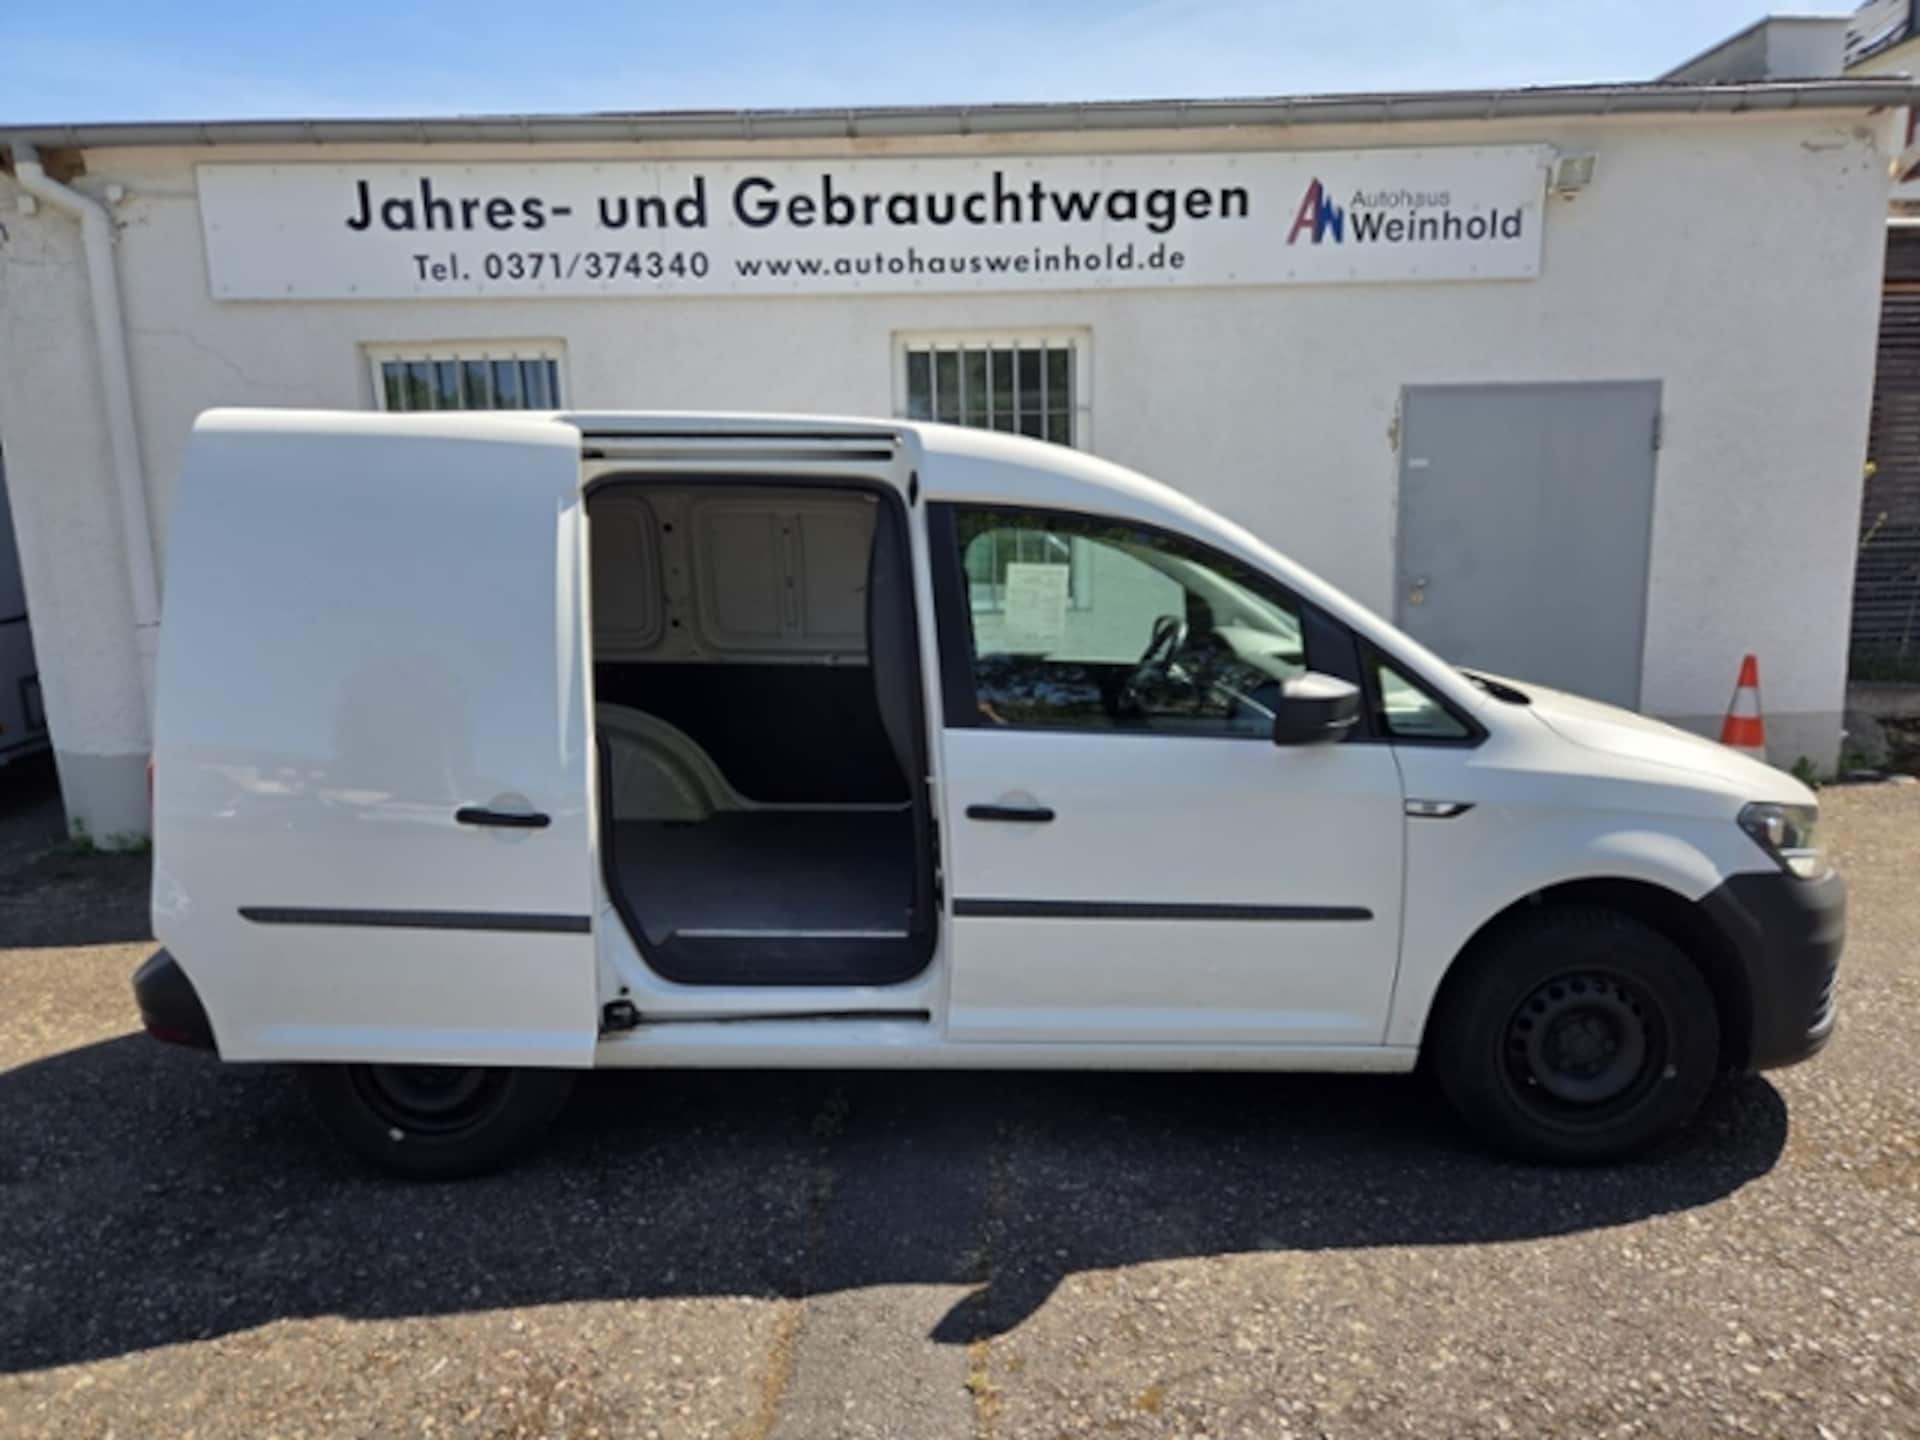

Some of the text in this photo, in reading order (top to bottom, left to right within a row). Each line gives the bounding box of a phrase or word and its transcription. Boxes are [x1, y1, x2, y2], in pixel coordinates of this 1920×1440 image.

[346, 170, 1250, 234] Jahres- und Gebrauchtwagen
[1350, 188, 1451, 208] Autohaus
[1350, 207, 1524, 245] Weinhold
[413, 243, 1187, 282] Tel. 0371/374340 www.autohausweinhold.de
